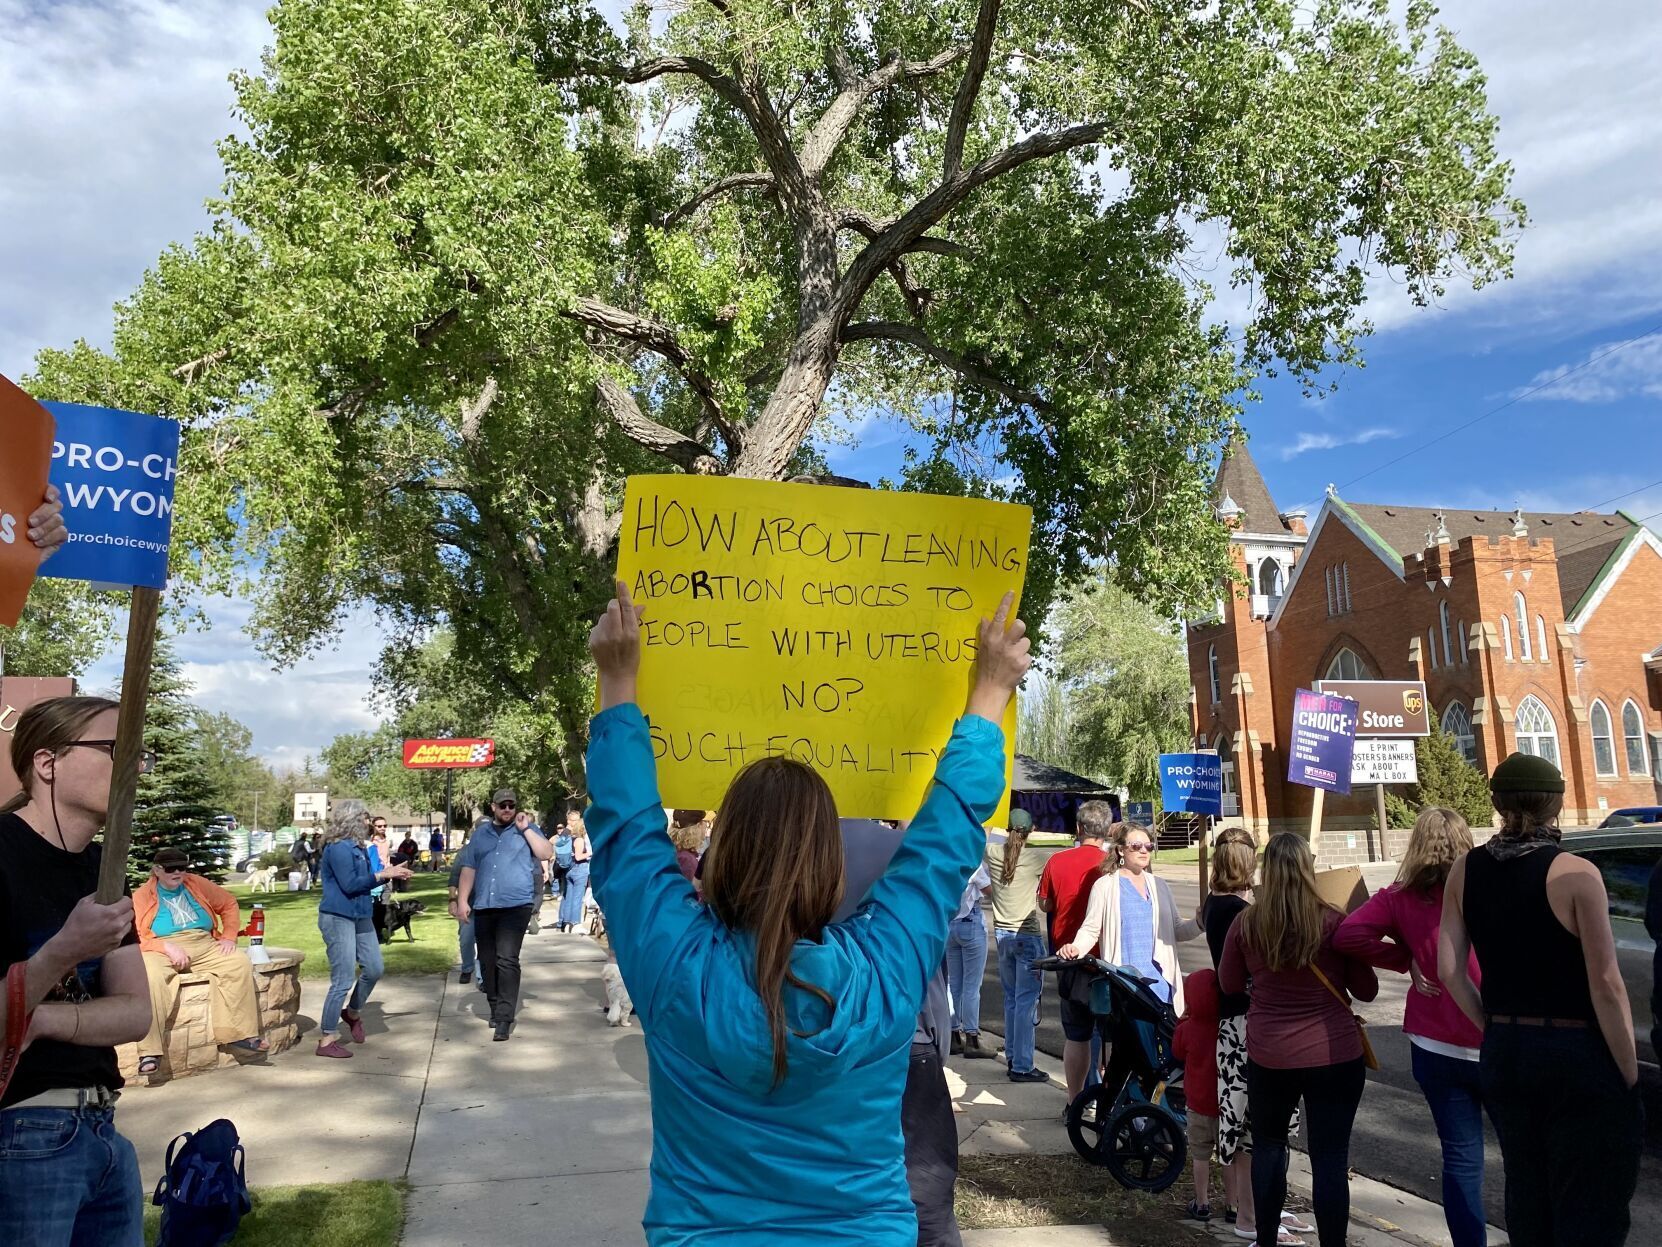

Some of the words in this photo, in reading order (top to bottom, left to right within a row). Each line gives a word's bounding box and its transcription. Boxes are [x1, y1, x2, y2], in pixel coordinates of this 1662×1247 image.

[635, 495, 737, 552] HOW
[752, 517, 880, 562] ABOUT
[881, 530, 1020, 573] LEAVING
[633, 570, 784, 602] ABORTION
[802, 581, 909, 607] CHOICES
[927, 586, 973, 610] TO
[639, 619, 749, 648] EOPLE
[772, 628, 851, 657] WITH
[867, 632, 978, 663] UTERUS
[782, 678, 864, 712] NO?
[1300, 694, 1326, 711] MEN
[1328, 700, 1343, 711] FOR
[1298, 711, 1351, 736] CHOICE:
[1362, 710, 1404, 728] Store
[416, 744, 469, 755] Advance
[649, 726, 747, 767] SUCH
[408, 755, 437, 764] Auto
[437, 755, 467, 763] Parts
[1372, 763, 1399, 771] ABOUT
[1176, 779, 1220, 791] WYOMING
[1392, 772, 1407, 780] BOX
